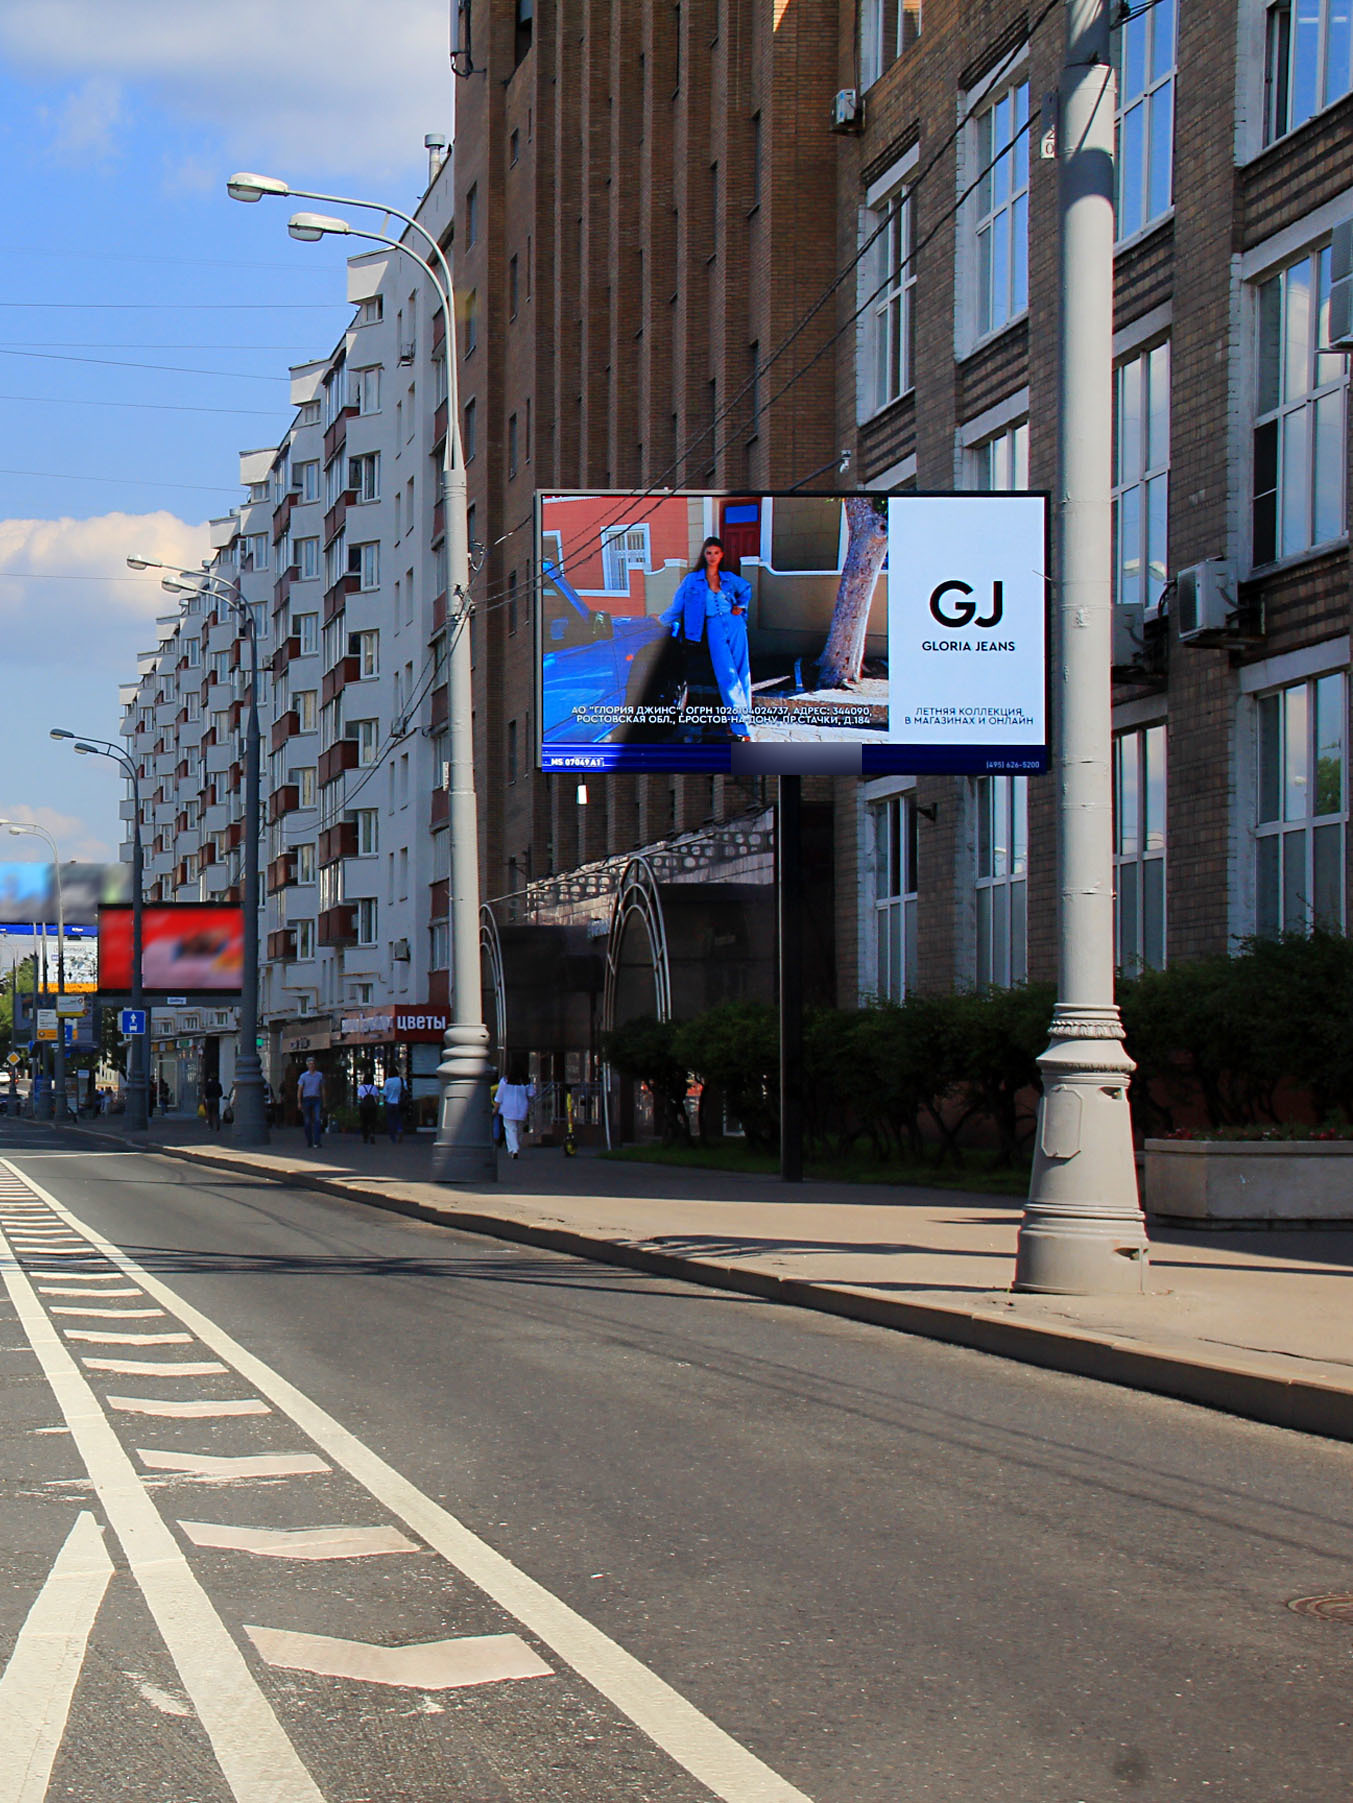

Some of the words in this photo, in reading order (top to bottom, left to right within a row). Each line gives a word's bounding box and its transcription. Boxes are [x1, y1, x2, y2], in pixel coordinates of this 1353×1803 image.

[929, 579, 1003, 628] GJ
[921, 641, 972, 652] GLORIA
[975, 641, 1016, 652] JEANS
[571, 706, 587, 715] АО
[685, 706, 713, 715] ОГРН
[793, 706, 830, 716] АДРЕС:
[832, 706, 873, 717] 344090,
[915, 707, 956, 716] ЛЕТНЯЯ
[959, 707, 1024, 717] КОЛЛЕКЦИЯ,
[576, 715, 646, 724] РОСТОВСКАЯ
[904, 717, 912, 725] В
[913, 717, 976, 725] МАГАЗИНАХ
[978, 717, 986, 725] И
[988, 716, 1034, 725] ОНЛАЙН
[1006, 761, 1040, 769] 626-5200
